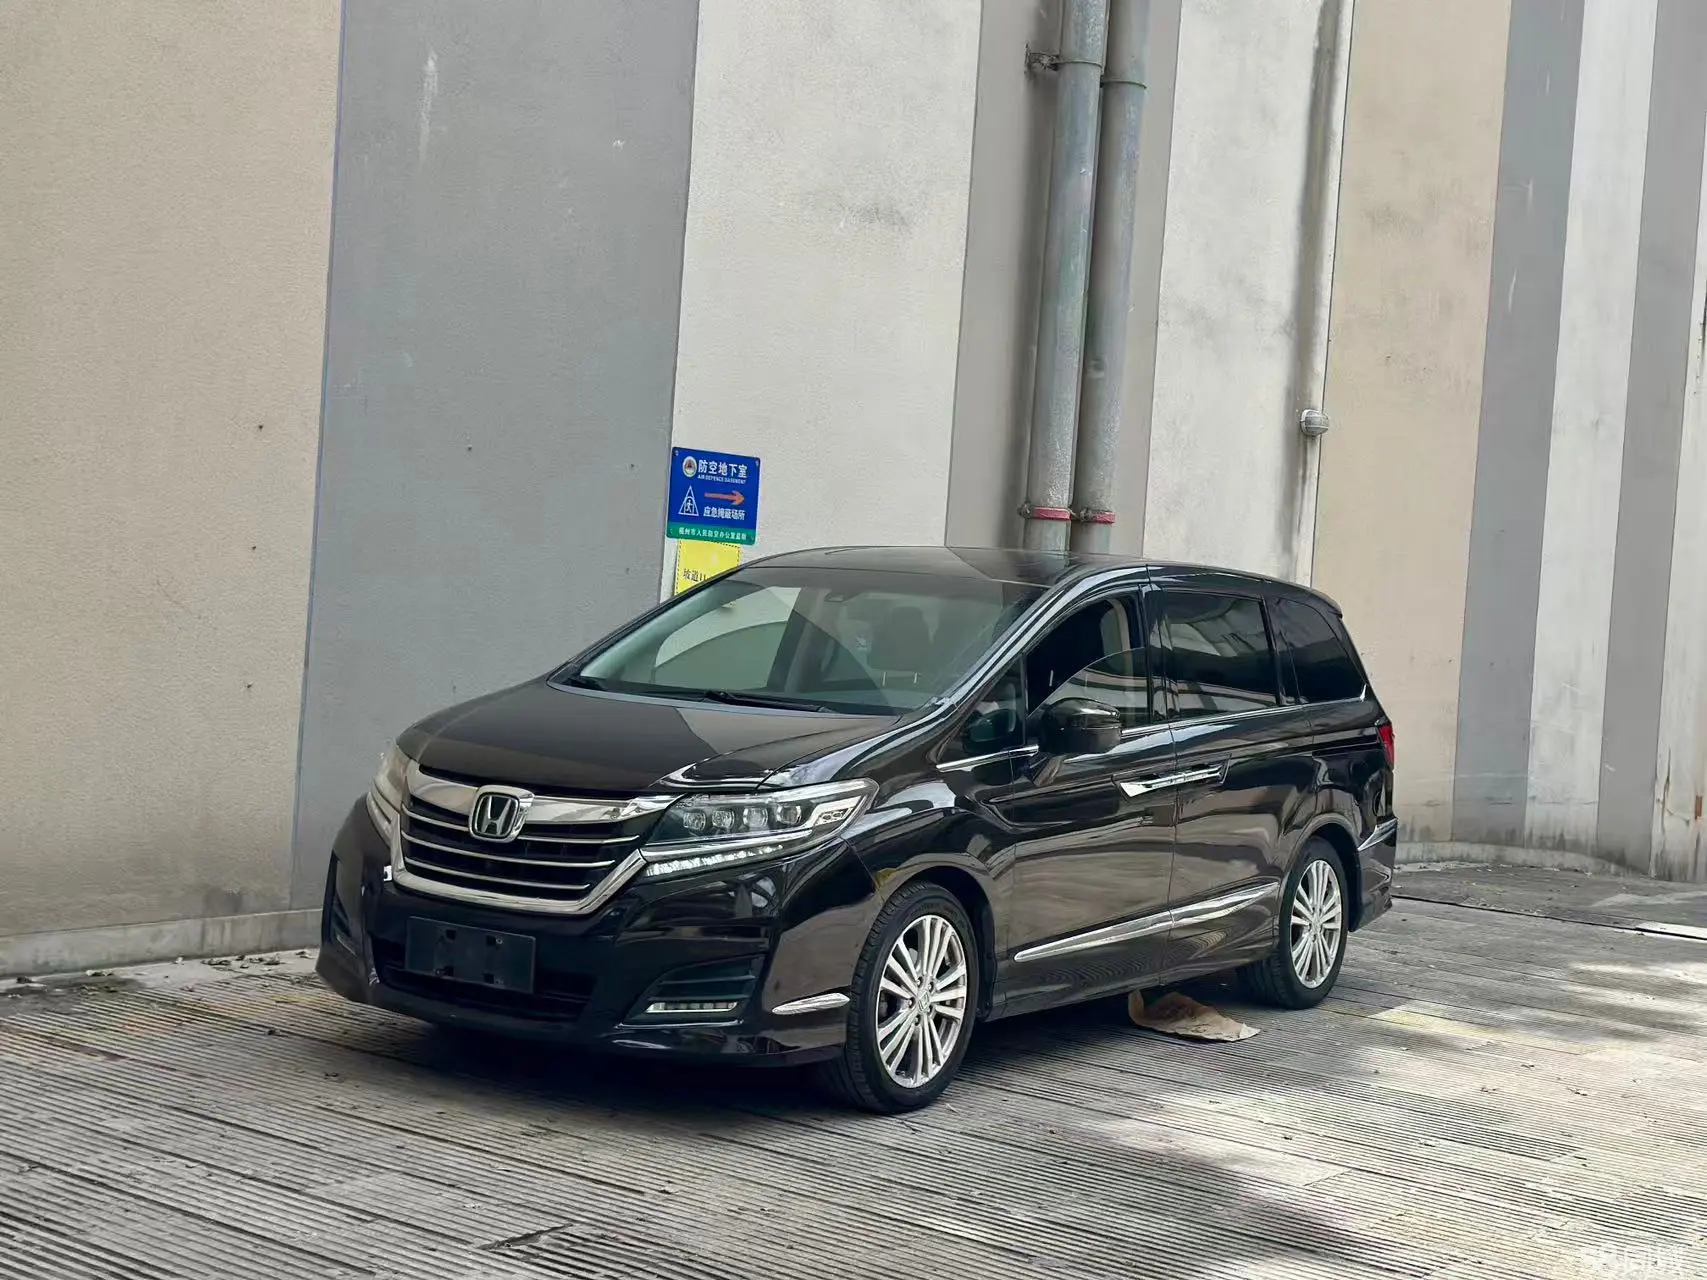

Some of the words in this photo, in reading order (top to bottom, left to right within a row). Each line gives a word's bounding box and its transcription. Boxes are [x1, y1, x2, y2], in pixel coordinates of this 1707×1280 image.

[698, 459, 748, 478] 防空地下室
